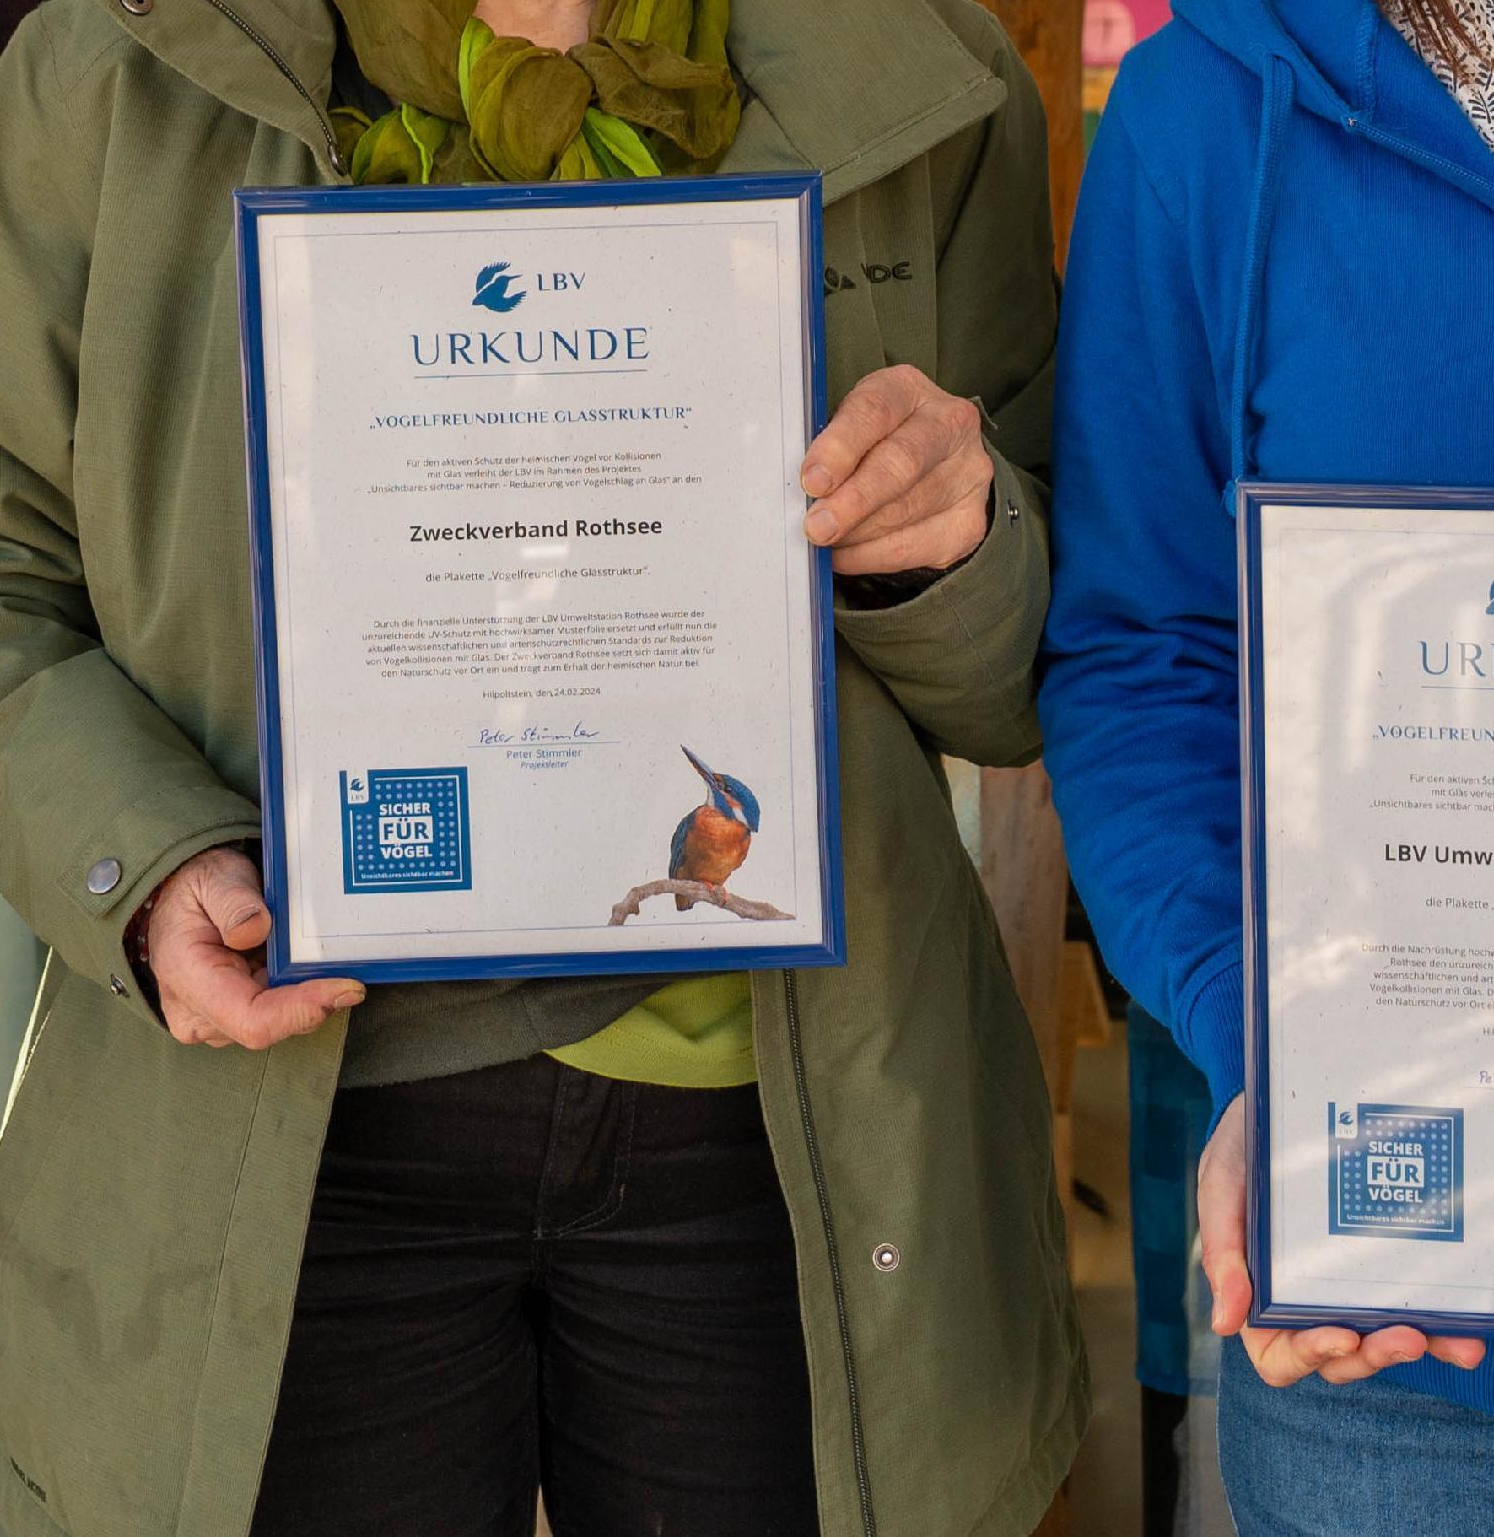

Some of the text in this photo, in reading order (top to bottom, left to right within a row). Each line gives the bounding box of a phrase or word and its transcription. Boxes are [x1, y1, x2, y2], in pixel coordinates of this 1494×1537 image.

[537, 272, 586, 291] LBV
[411, 327, 650, 366] URKUNDE
[369, 406, 693, 430] „VOGELFREUNDLICHE GLASSTRUKTUR“
[409, 518, 663, 543] Zweckverband Rothsee
[507, 748, 582, 759] Peter Stimmler
[379, 802, 432, 817] SICHER
[383, 817, 430, 840] FÜR
[379, 842, 434, 860] VÖGEL
[1385, 843, 1428, 863] LBV
[1368, 1140, 1424, 1156] SICHER
[1371, 1157, 1420, 1184] FÜR
[1368, 1184, 1424, 1204] VÖGEL
